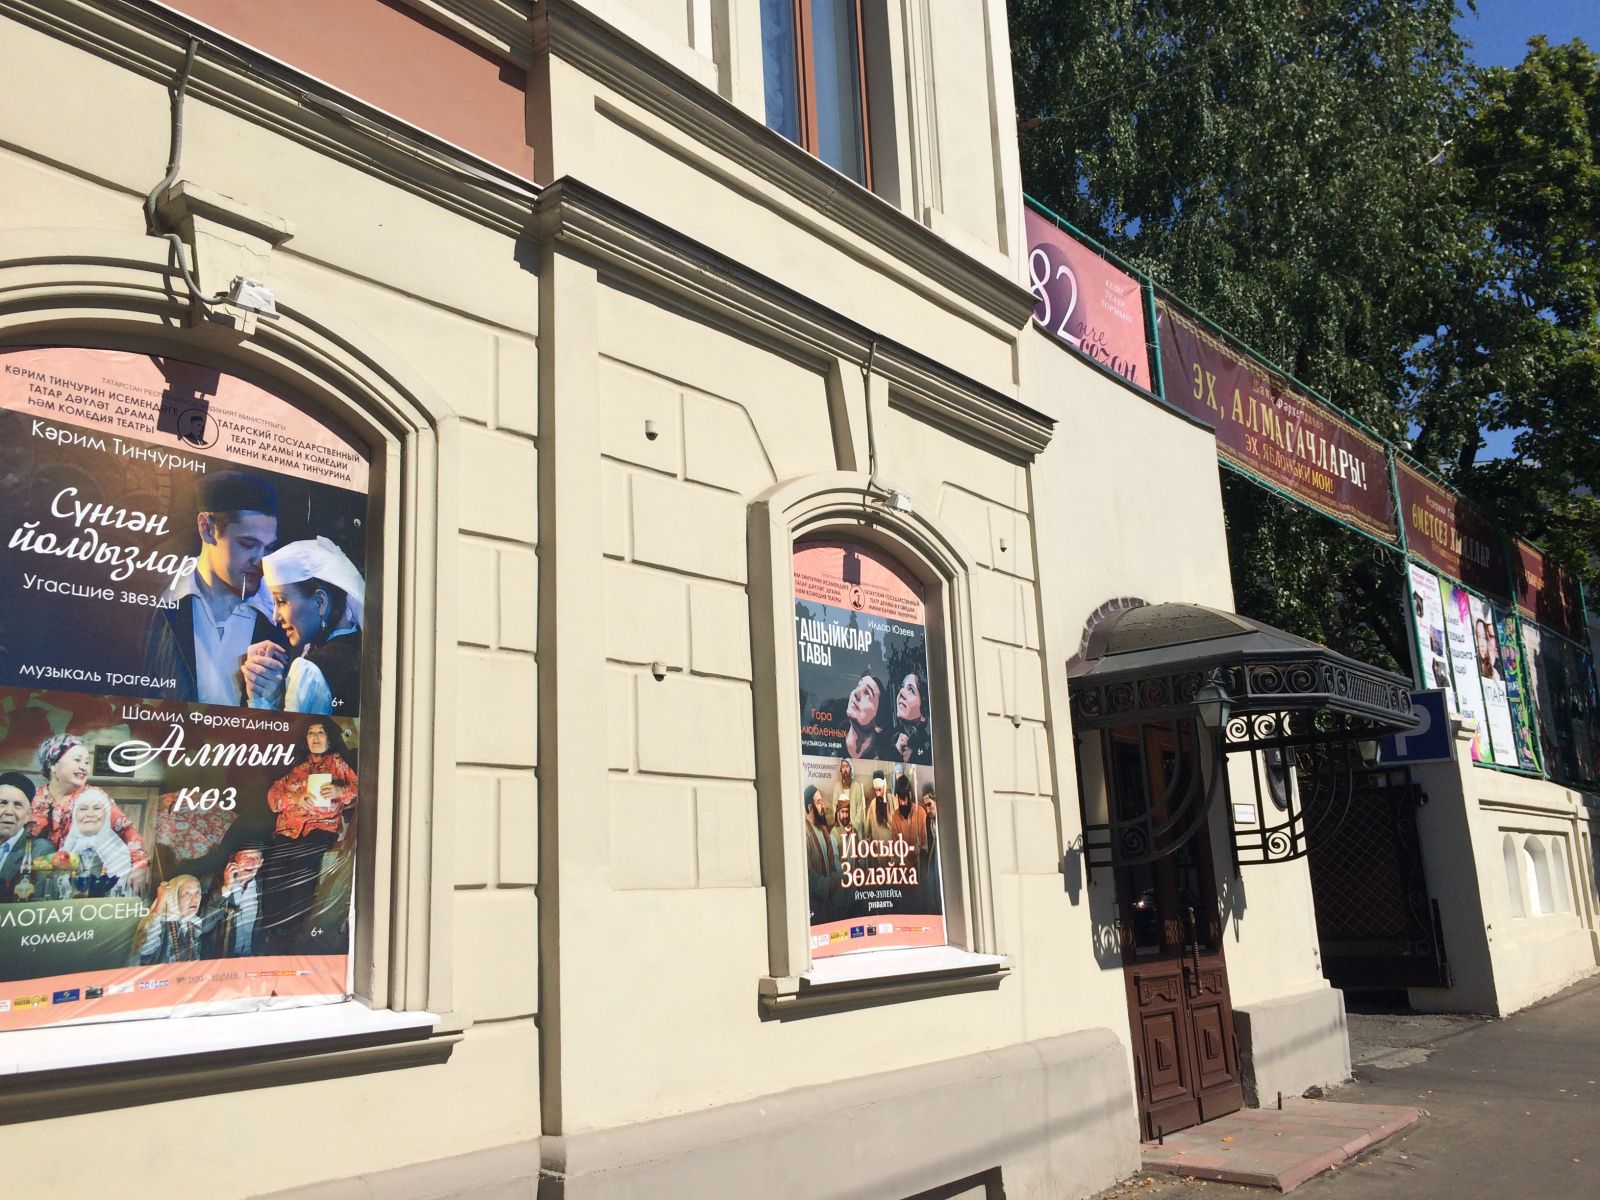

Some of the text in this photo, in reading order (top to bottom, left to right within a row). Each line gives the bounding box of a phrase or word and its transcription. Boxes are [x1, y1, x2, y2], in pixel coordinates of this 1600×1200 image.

[1029, 249, 1081, 347] 82
[5, 364, 46, 382] КӘРИМ
[50, 376, 105, 397] ТИНЧУРИН
[109, 392, 179, 416] ИСЕМЕНДӘГЕ
[29, 383, 155, 421] ТАТАР ДӘҮЛӘТ ДРАМА
[28, 396, 155, 434] ҺӘМ КОМЕДИЯ ТЕАТРЫ
[1193, 363, 1224, 420] ЭХ,
[1232, 389, 1368, 490] АЛМАГАЧЛАРЫ!
[32, 419, 207, 474] Кәрим Тинчурин
[218, 419, 360, 463] ТАТАРСКИЙ ГОСУДАРСТВЕННЫЙ
[231, 434, 348, 471] ТЕАТР ДРАМЫ И КОМЕДИИ
[226, 445, 351, 482] ИМЕНИ КАРИМА ТИНЧУРИНА
[50, 486, 170, 536] Сүнгән
[8, 520, 199, 590] йолдызлар
[23, 573, 181, 610] Угасшие звезды
[799, 641, 832, 667] ТАВЫ
[19, 663, 177, 689] музыкаль трагедия
[122, 705, 290, 732] Шамил Фәрхетдинов
[331, 697, 345, 708] 6+
[811, 708, 832, 722] Гора
[107, 723, 295, 774] Алтын
[173, 786, 237, 813] көз
[841, 827, 915, 866] Йосыф-
[841, 861, 918, 888] Зөләйха
[0, 902, 150, 927] ЛОТАЯ ОСЕНЬ
[310, 926, 324, 937] 6+
[21, 930, 94, 947] комедия
